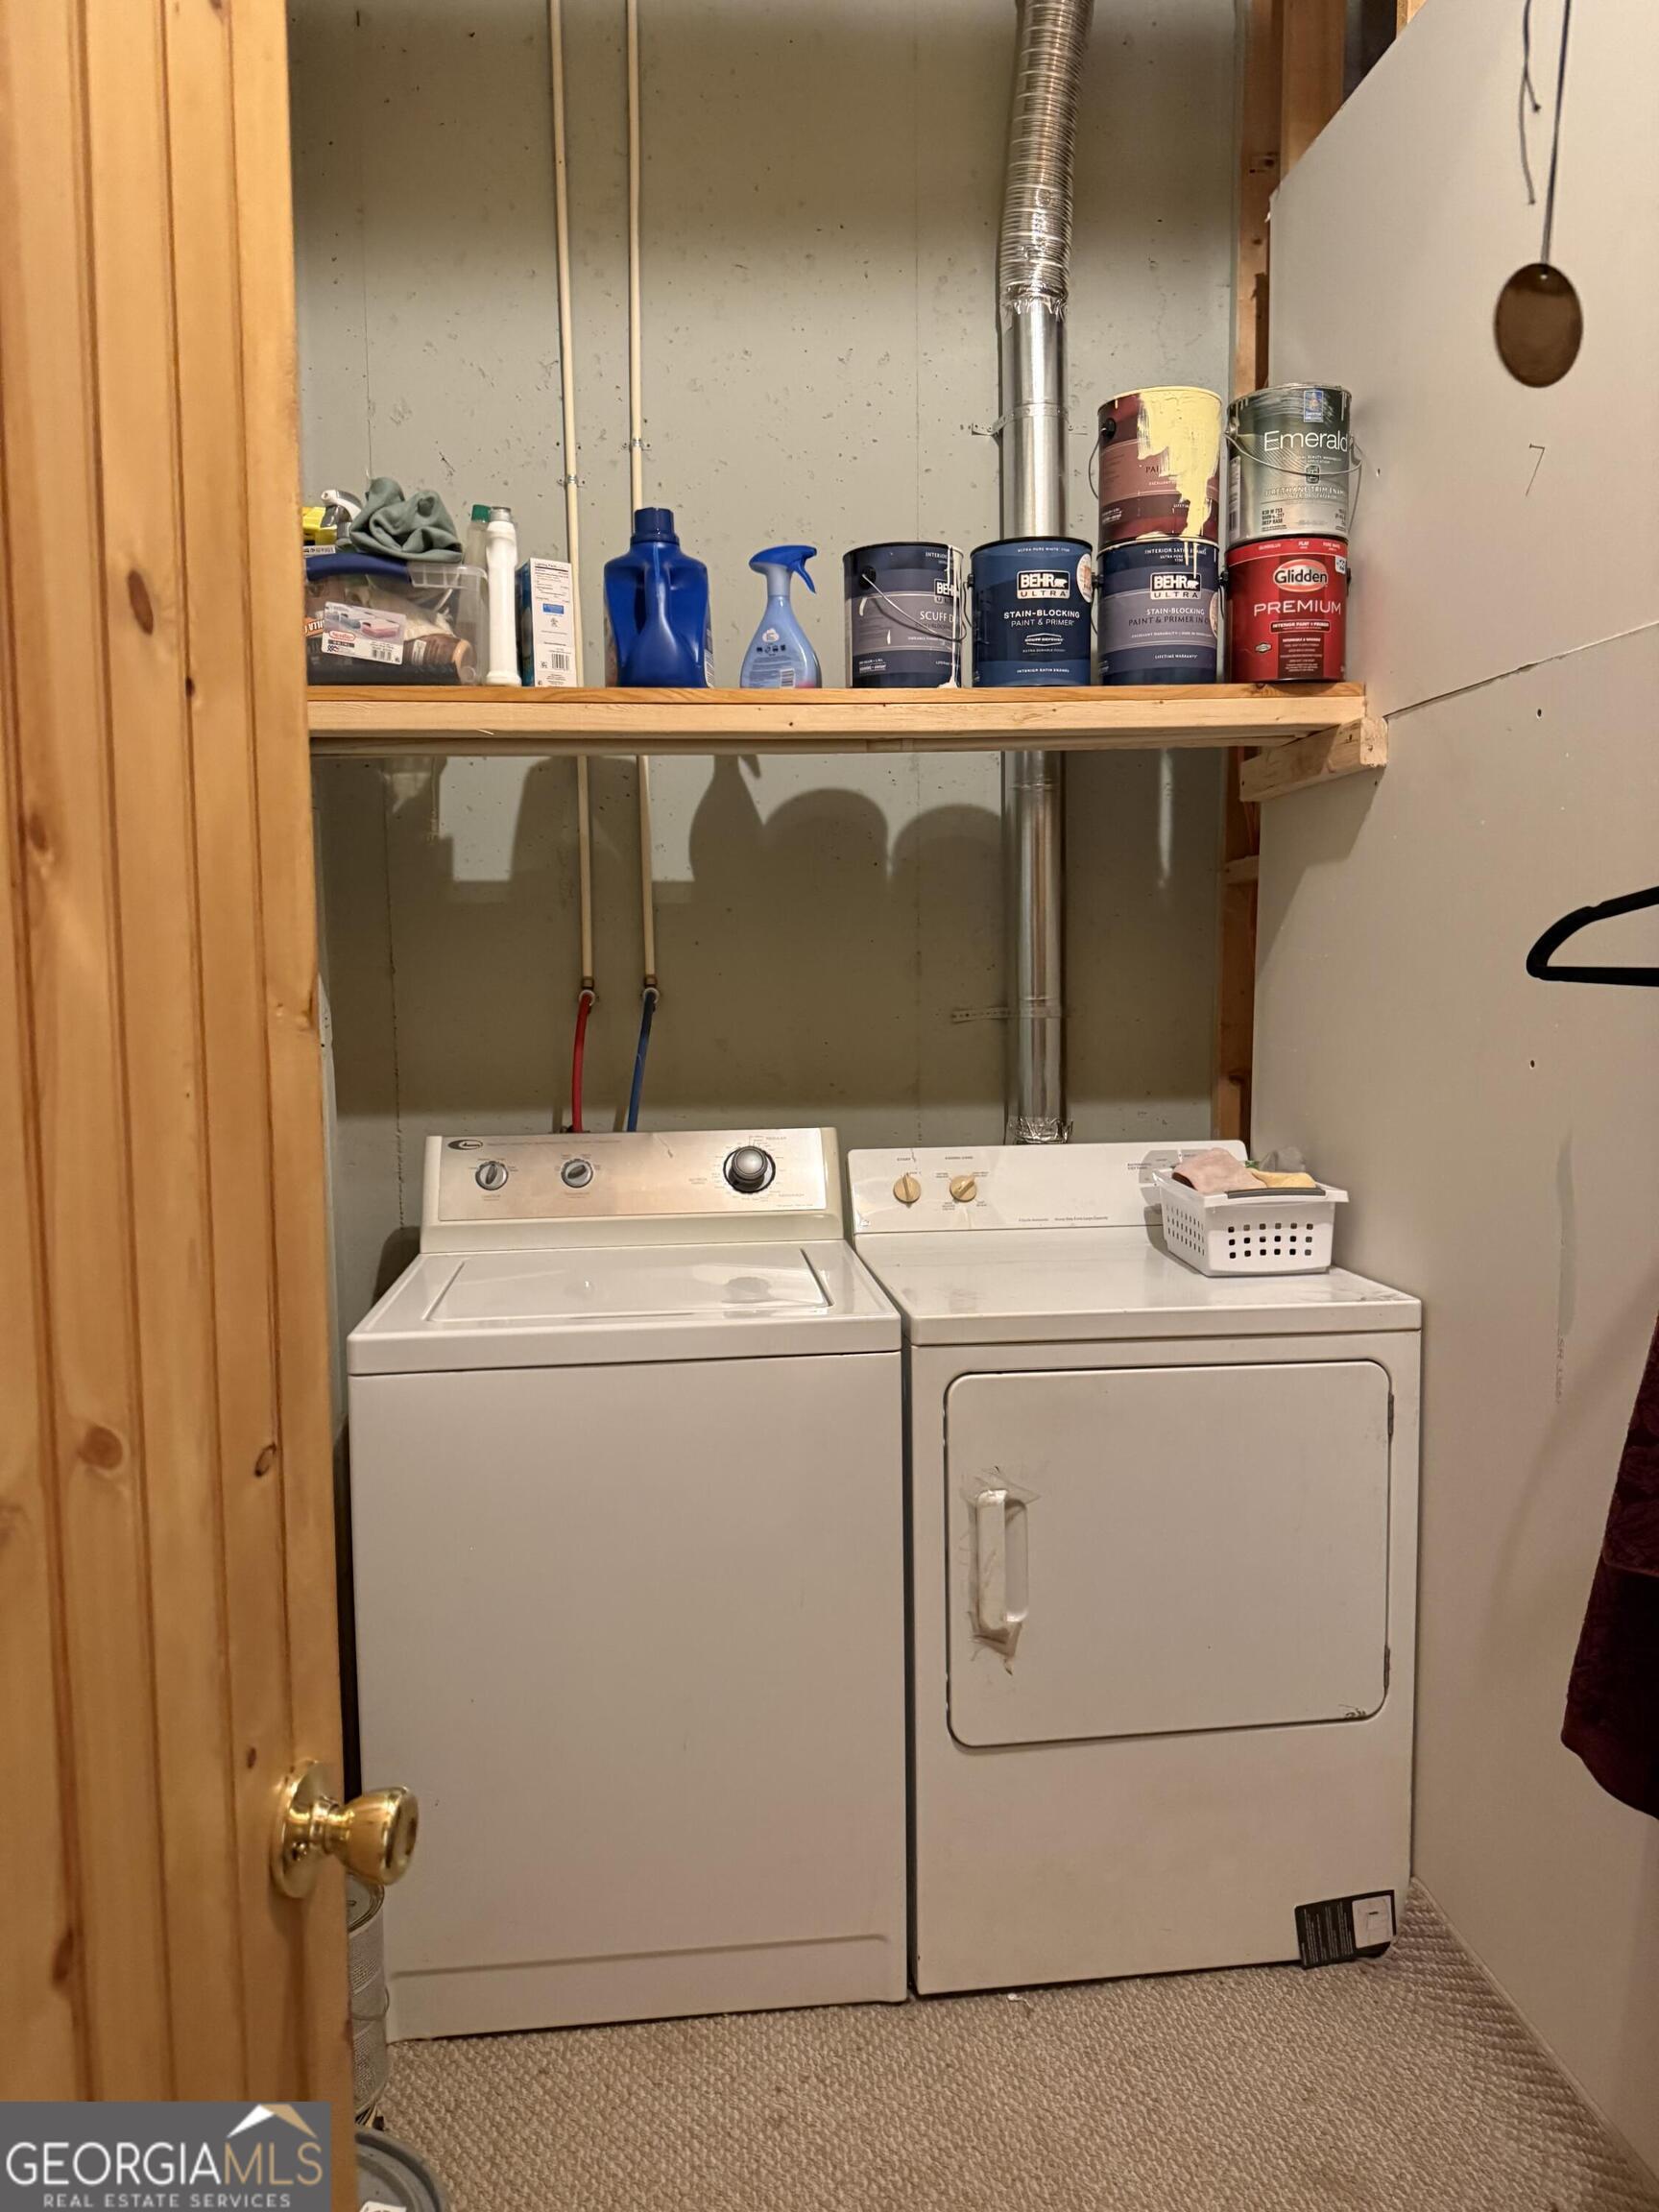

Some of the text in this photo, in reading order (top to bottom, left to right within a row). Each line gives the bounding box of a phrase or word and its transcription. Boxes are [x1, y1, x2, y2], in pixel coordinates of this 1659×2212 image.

[1263, 430, 1348, 452] Emerald
[925, 551, 948, 560] INTERIO
[1021, 573, 1055, 589] BEHR
[1154, 574, 1188, 589] BEHR
[1273, 569, 1329, 584] Glidden
[1003, 610, 1081, 619] STAIN-BLOCKING
[1253, 600, 1341, 617] PREMIUM
[920, 611, 948, 621] SCUFF
[1128, 616, 1153, 626] PAINT
[1011, 618, 1035, 627] PAINT
